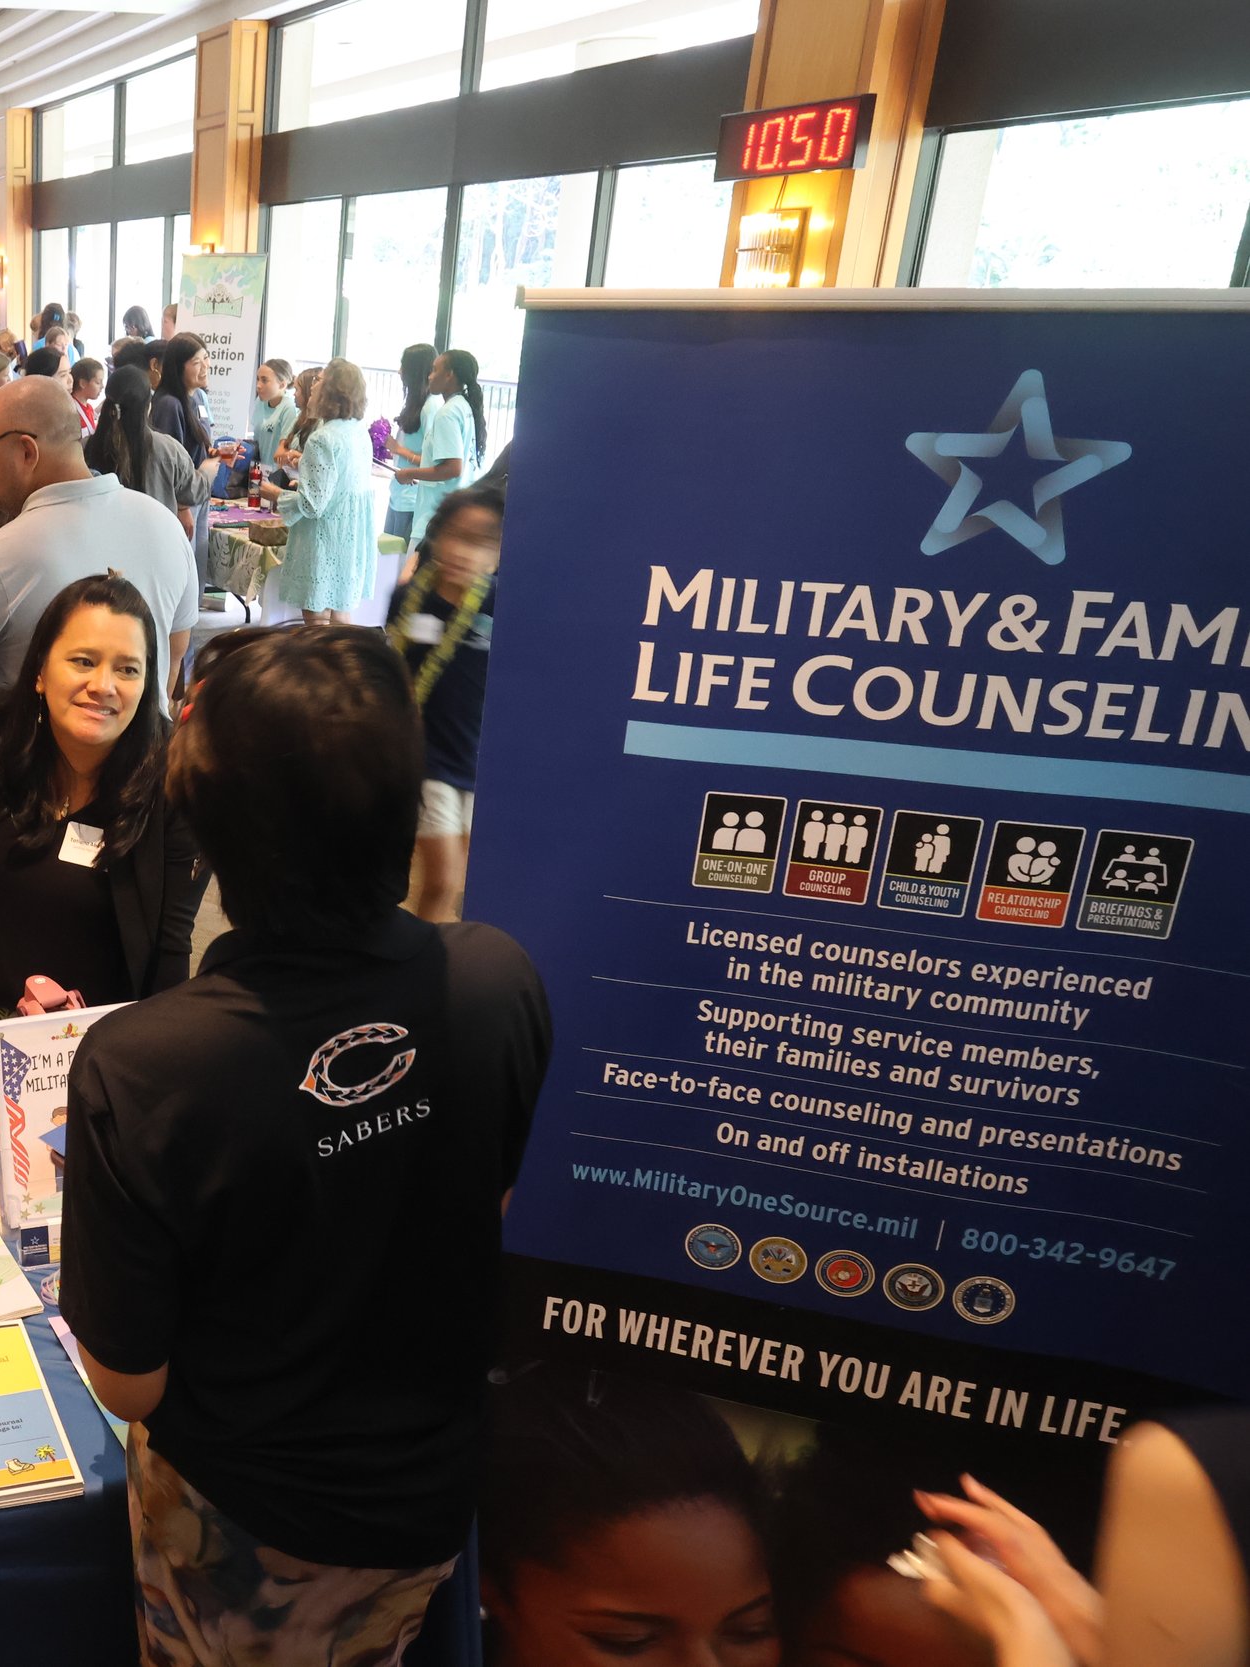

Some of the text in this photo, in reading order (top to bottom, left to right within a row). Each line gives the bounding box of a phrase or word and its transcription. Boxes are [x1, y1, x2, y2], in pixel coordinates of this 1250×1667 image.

[642, 565, 990, 647] MILITARY
[631, 641, 775, 710] LIFE
[702, 860, 768, 876] ONE-ON-ONE
[809, 869, 846, 885] GROUP
[708, 872, 758, 885] COUNSELING
[799, 882, 851, 896] COUNSELING
[889, 880, 960, 899] CHILD & YOUTH
[895, 893, 949, 908] COUNSELING
[987, 892, 1062, 909] RELATIONSHIP
[994, 905, 1049, 919] COUNSELING
[1089, 901, 1163, 920] BRIEFINGS &
[1087, 914, 1161, 931] PRESENTATIONS
[686, 922, 1153, 1000] Licensed counselors experienced
[727, 957, 1090, 1030] in the military community
[697, 1000, 1100, 1081] Supporting service members,
[31, 1053, 52, 1071] I'M
[56, 1052, 64, 1067] A
[705, 1031, 1080, 1106] their families and survivors
[25, 1074, 67, 1093] MILITA
[603, 1064, 1182, 1170] Face-to-face counseling and presentations
[317, 1098, 431, 1157] SABERS
[717, 1123, 1029, 1194] On and off installations
[573, 1164, 918, 1238] www.MilitaryOneSource.mil
[962, 1229, 1176, 1280] 800-342-9647
[543, 1296, 606, 1338] FOR
[619, 1309, 804, 1381] WHEREVER
[819, 1351, 890, 1399] YOU
[898, 1371, 977, 1419] ARE
[985, 1387, 1029, 1428] IN
[11, 1423, 23, 1432] to:
